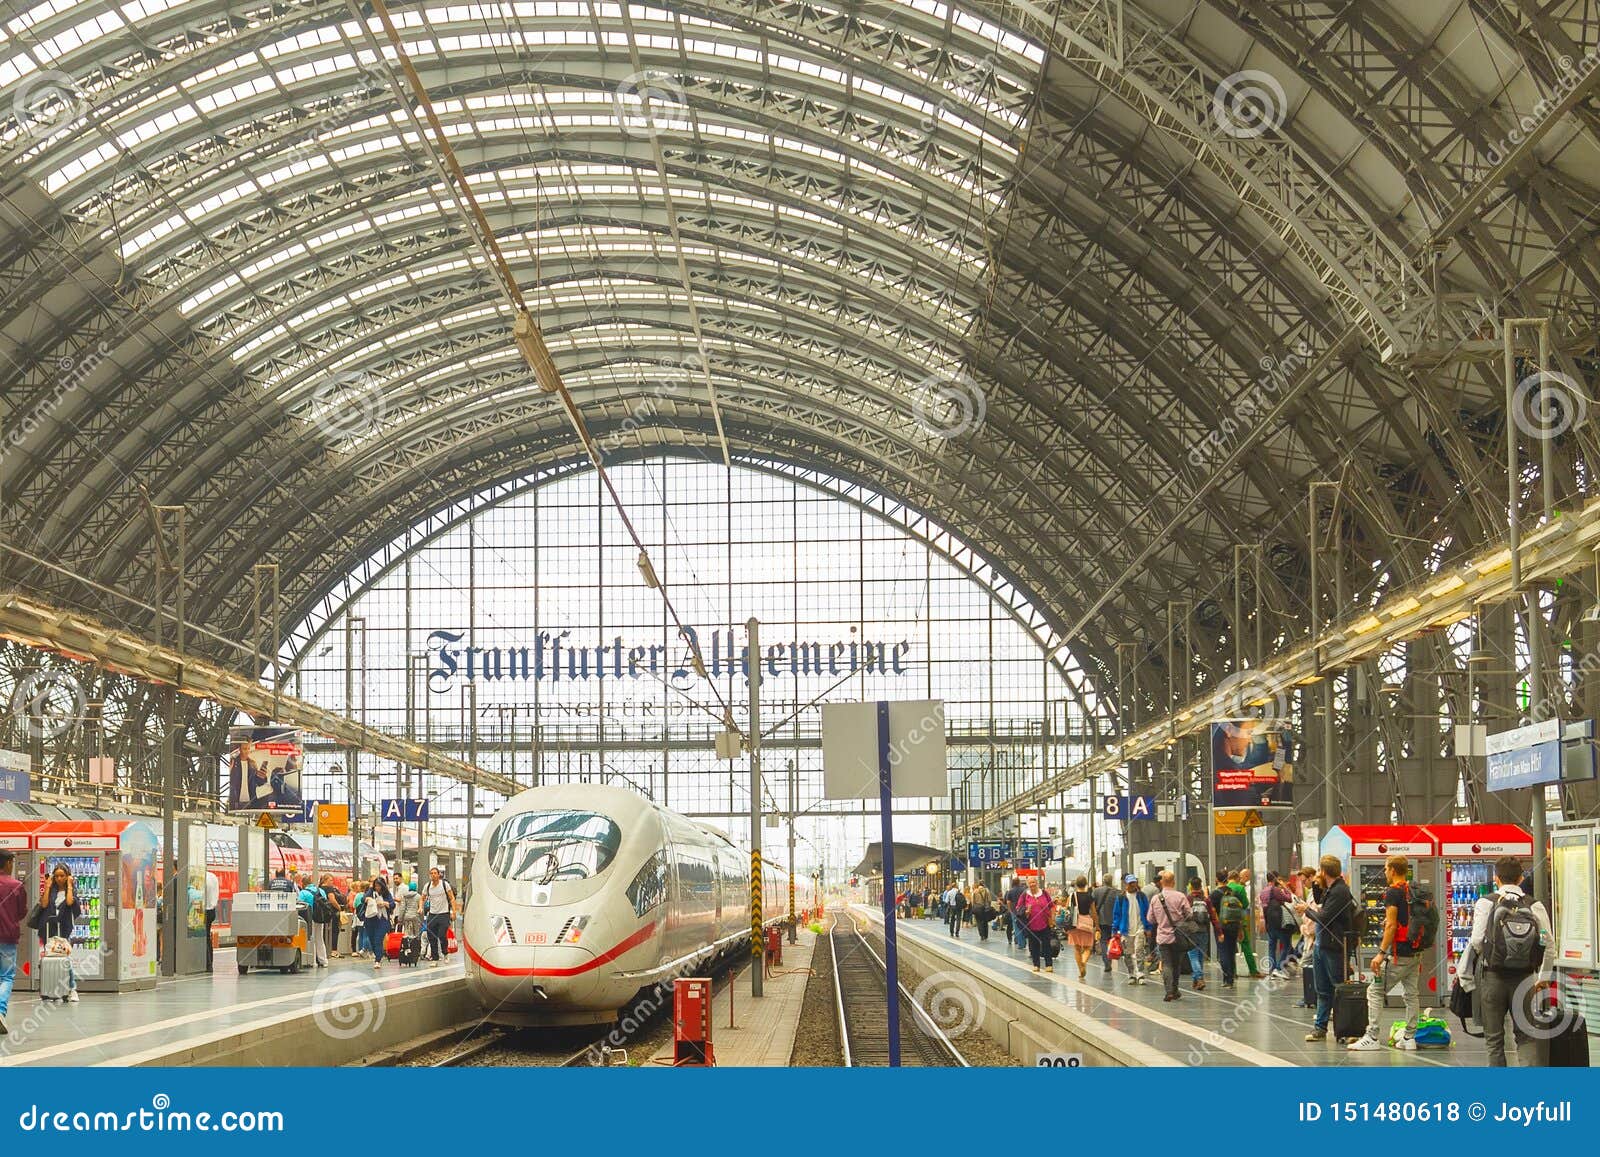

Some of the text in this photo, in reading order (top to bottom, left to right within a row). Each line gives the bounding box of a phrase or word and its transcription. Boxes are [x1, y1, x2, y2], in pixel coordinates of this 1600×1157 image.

[426, 630, 665, 693] Frankfurter
[480, 702, 591, 718] ZEITUNG
[386, 799, 426, 818] A 7
[1106, 796, 1149, 815] 8 A
[527, 934, 544, 943] DB
